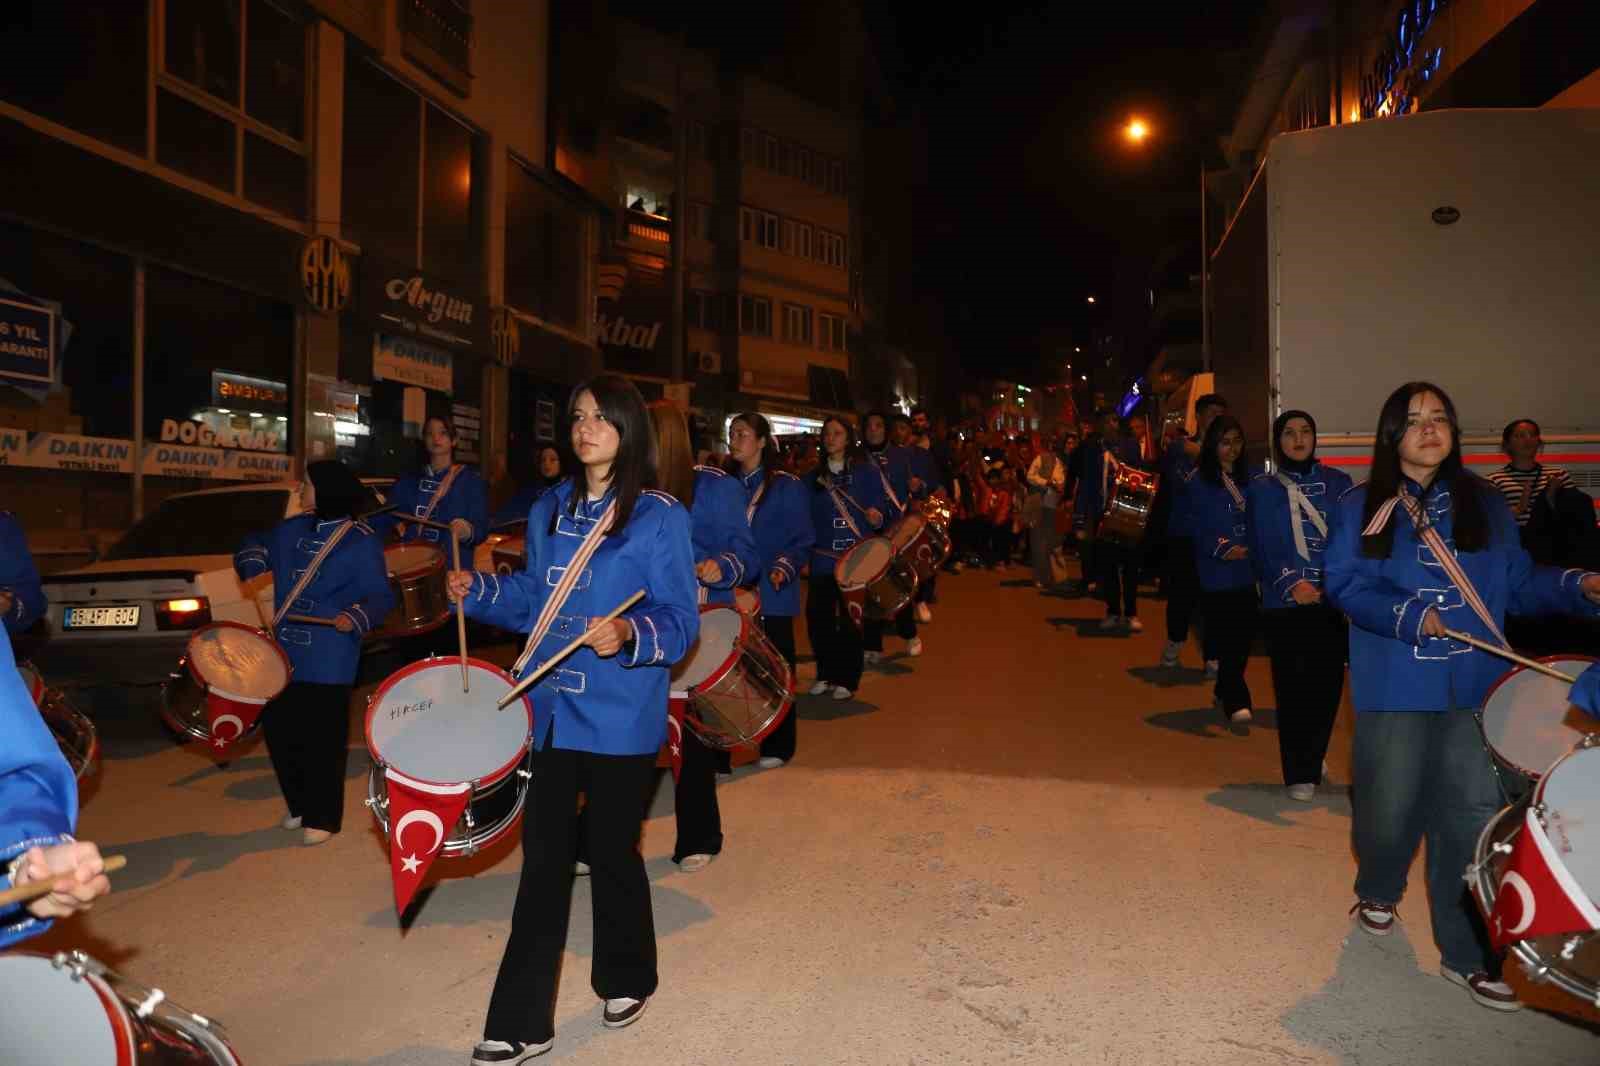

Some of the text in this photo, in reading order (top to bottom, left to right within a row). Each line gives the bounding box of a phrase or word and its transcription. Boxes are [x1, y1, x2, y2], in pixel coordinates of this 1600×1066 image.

[385, 276, 474, 324] Argun
[49, 438, 129, 459] DAIKIN
[156, 448, 220, 467] DAIKIN
[237, 455, 291, 473] DAIKIN
